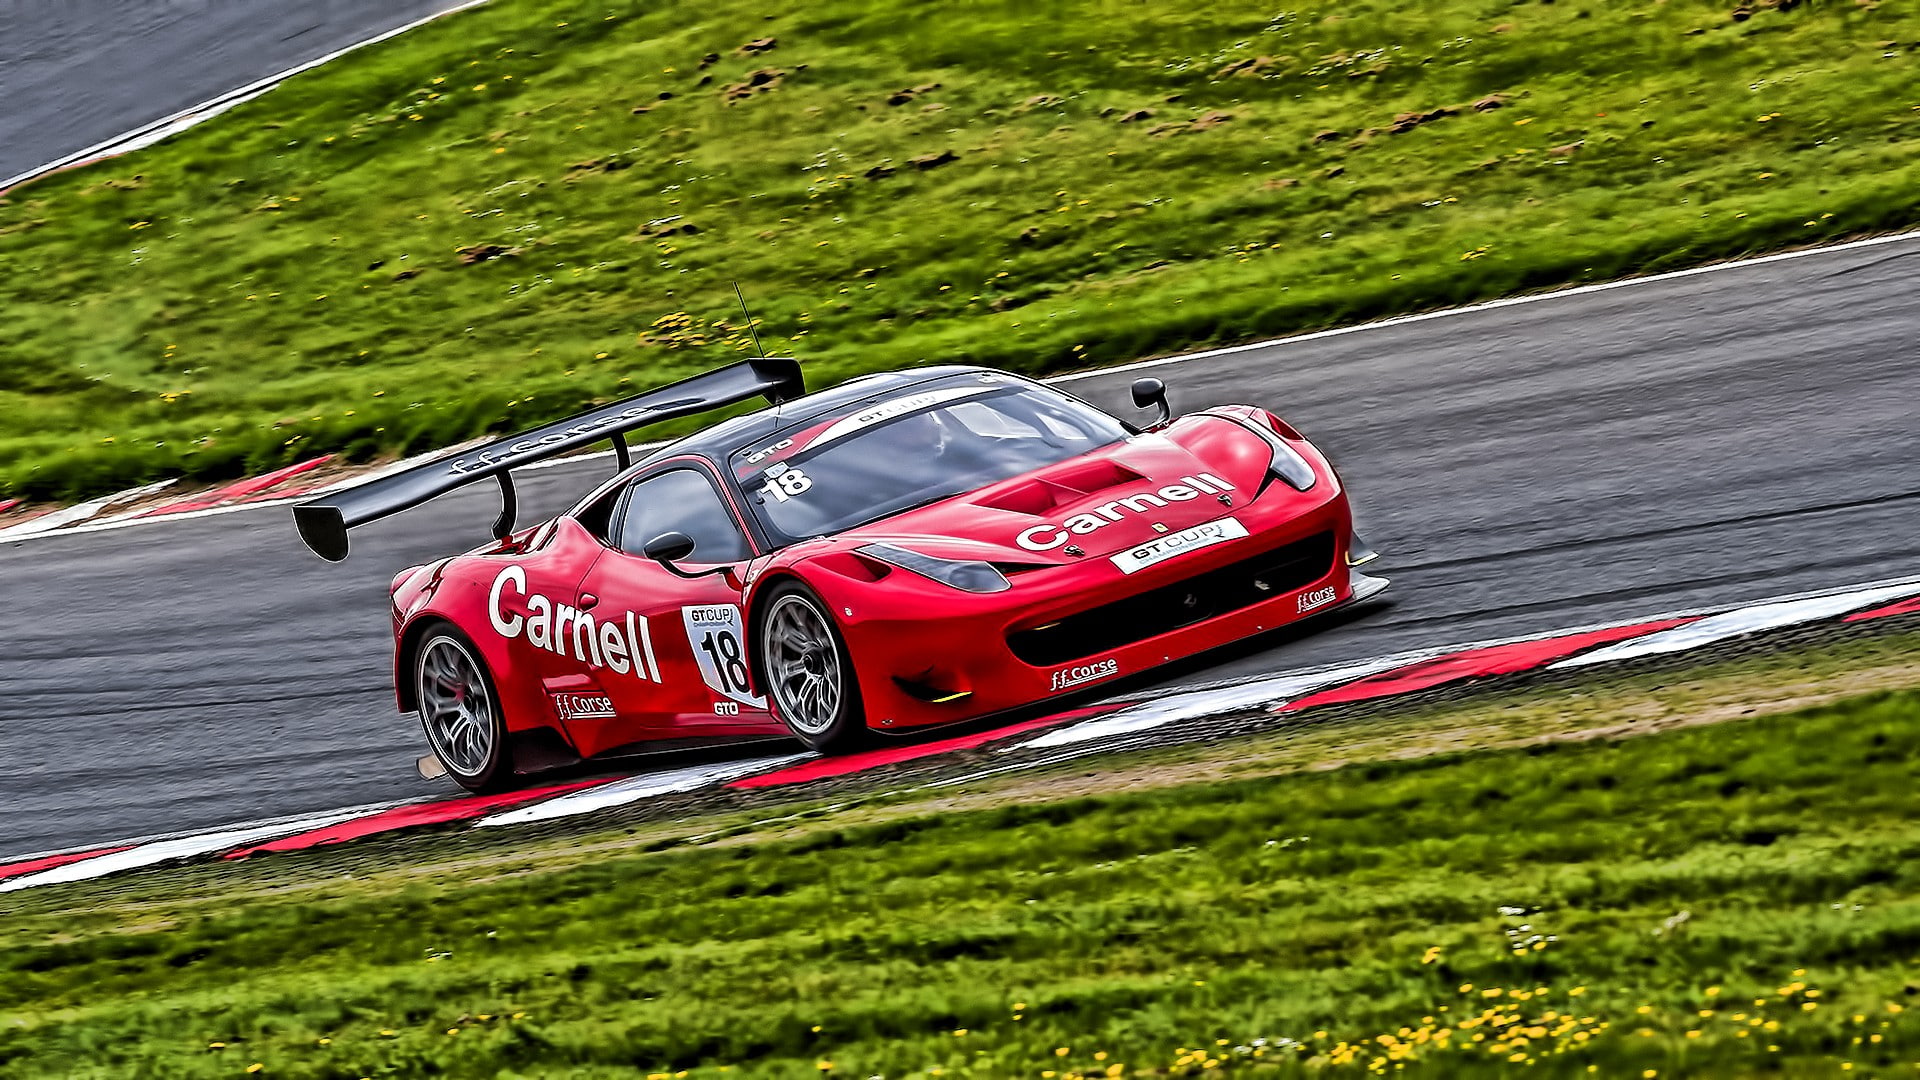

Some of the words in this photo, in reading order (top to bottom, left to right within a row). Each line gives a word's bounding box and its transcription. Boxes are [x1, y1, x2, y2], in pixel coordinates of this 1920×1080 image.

[746, 438, 794, 465] GTO
[758, 469, 813, 503] 18
[1015, 472, 1236, 551] Carnell
[488, 564, 662, 684] Carnell
[700, 630, 751, 694] 18
[714, 702, 739, 715] GTO
